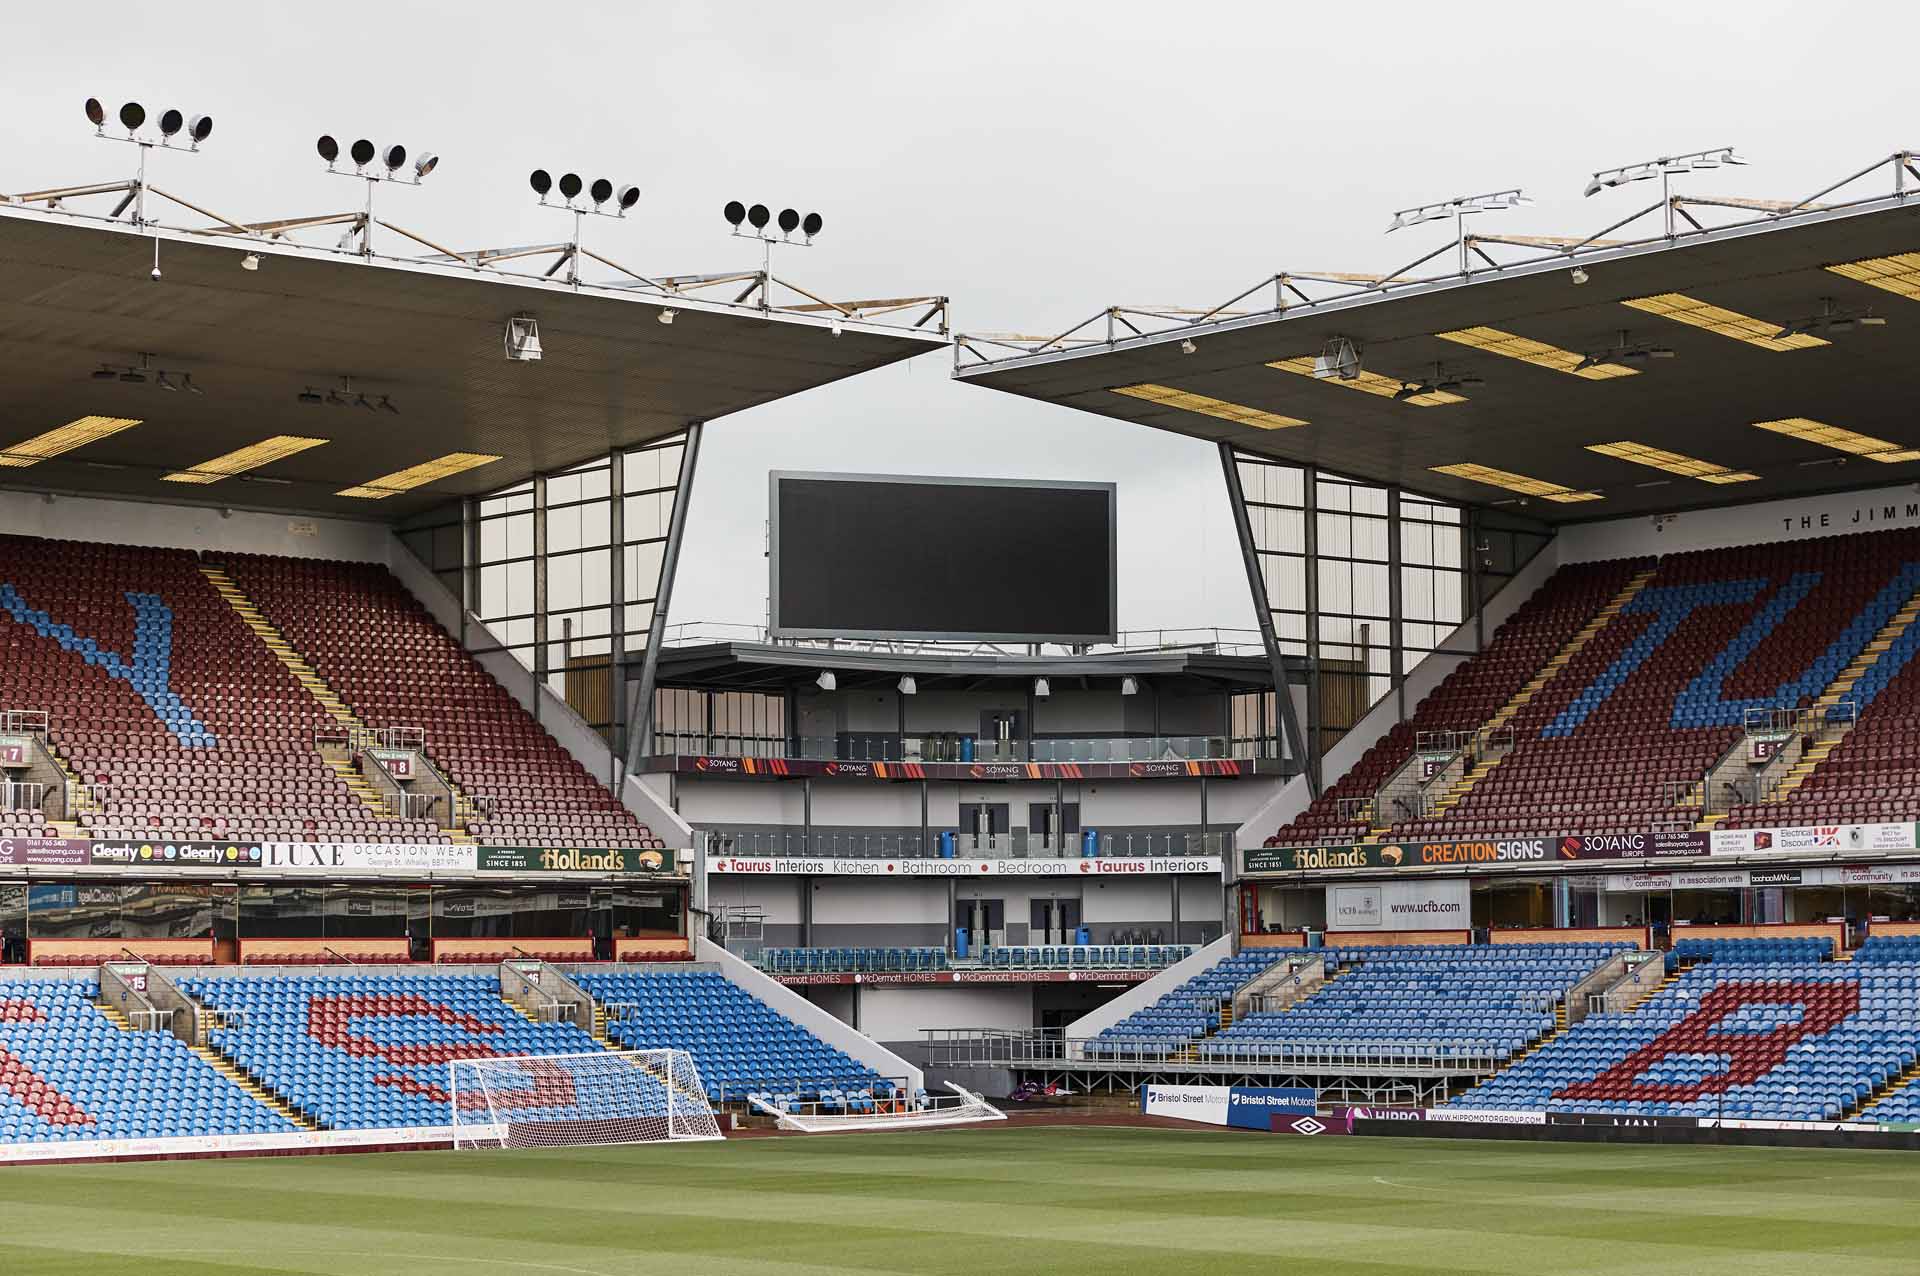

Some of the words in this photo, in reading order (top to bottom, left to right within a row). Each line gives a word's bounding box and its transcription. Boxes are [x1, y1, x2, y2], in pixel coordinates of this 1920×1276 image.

[1783, 513, 1830, 531] THE
[1852, 503, 1919, 523] JIMM
[399, 761, 407, 773] 8
[709, 759, 738, 768] SOYANG
[839, 764, 868, 773] SOYANG
[1146, 764, 1179, 772] SOYANG
[985, 765, 1019, 774] SOYANG
[1780, 828, 1813, 838] Electrical
[1584, 834, 1645, 851] SOYANG
[1780, 838, 1813, 848] Discount
[92, 844, 139, 862] Clearly
[180, 844, 224, 863] Clearly
[269, 844, 345, 866] LUXE
[354, 845, 428, 856] OCCASION
[436, 846, 473, 857] WEAR
[539, 848, 625, 870] Holland's
[1292, 846, 1367, 869] Holland's
[730, 859, 772, 872] Taurus
[775, 859, 824, 873] Interiors
[833, 860, 879, 874] Kitchen
[902, 861, 972, 874] Bathroom
[998, 861, 1067, 874] Bedroom
[1096, 860, 1146, 873] Taurus
[1150, 858, 1209, 872] Interiors
[1269, 860, 1282, 868] 1851
[1686, 876, 1727, 884] association
[1727, 874, 1743, 882] with
[1852, 872, 1893, 880] community
[1634, 880, 1672, 888] community
[1391, 900, 1460, 913] www.ucfb.com
[810, 974, 841, 984] HOMES
[862, 974, 902, 983] McDermott
[904, 973, 937, 982] HOMES
[962, 972, 1010, 982] McDermott
[1012, 972, 1050, 981] HOMES
[1078, 972, 1128, 980] McDermott
[1130, 972, 1159, 980] HOM
[132, 976, 146, 990] 15
[1158, 1093, 1181, 1102] Bristol
[1182, 1094, 1204, 1103] Street
[1242, 1096, 1266, 1105] Bristol
[1266, 1096, 1290, 1106] Street
[1290, 1096, 1315, 1107] Motors
[1430, 1114, 1542, 1124] WWW.HIPPOMOTORGROUP.COM
